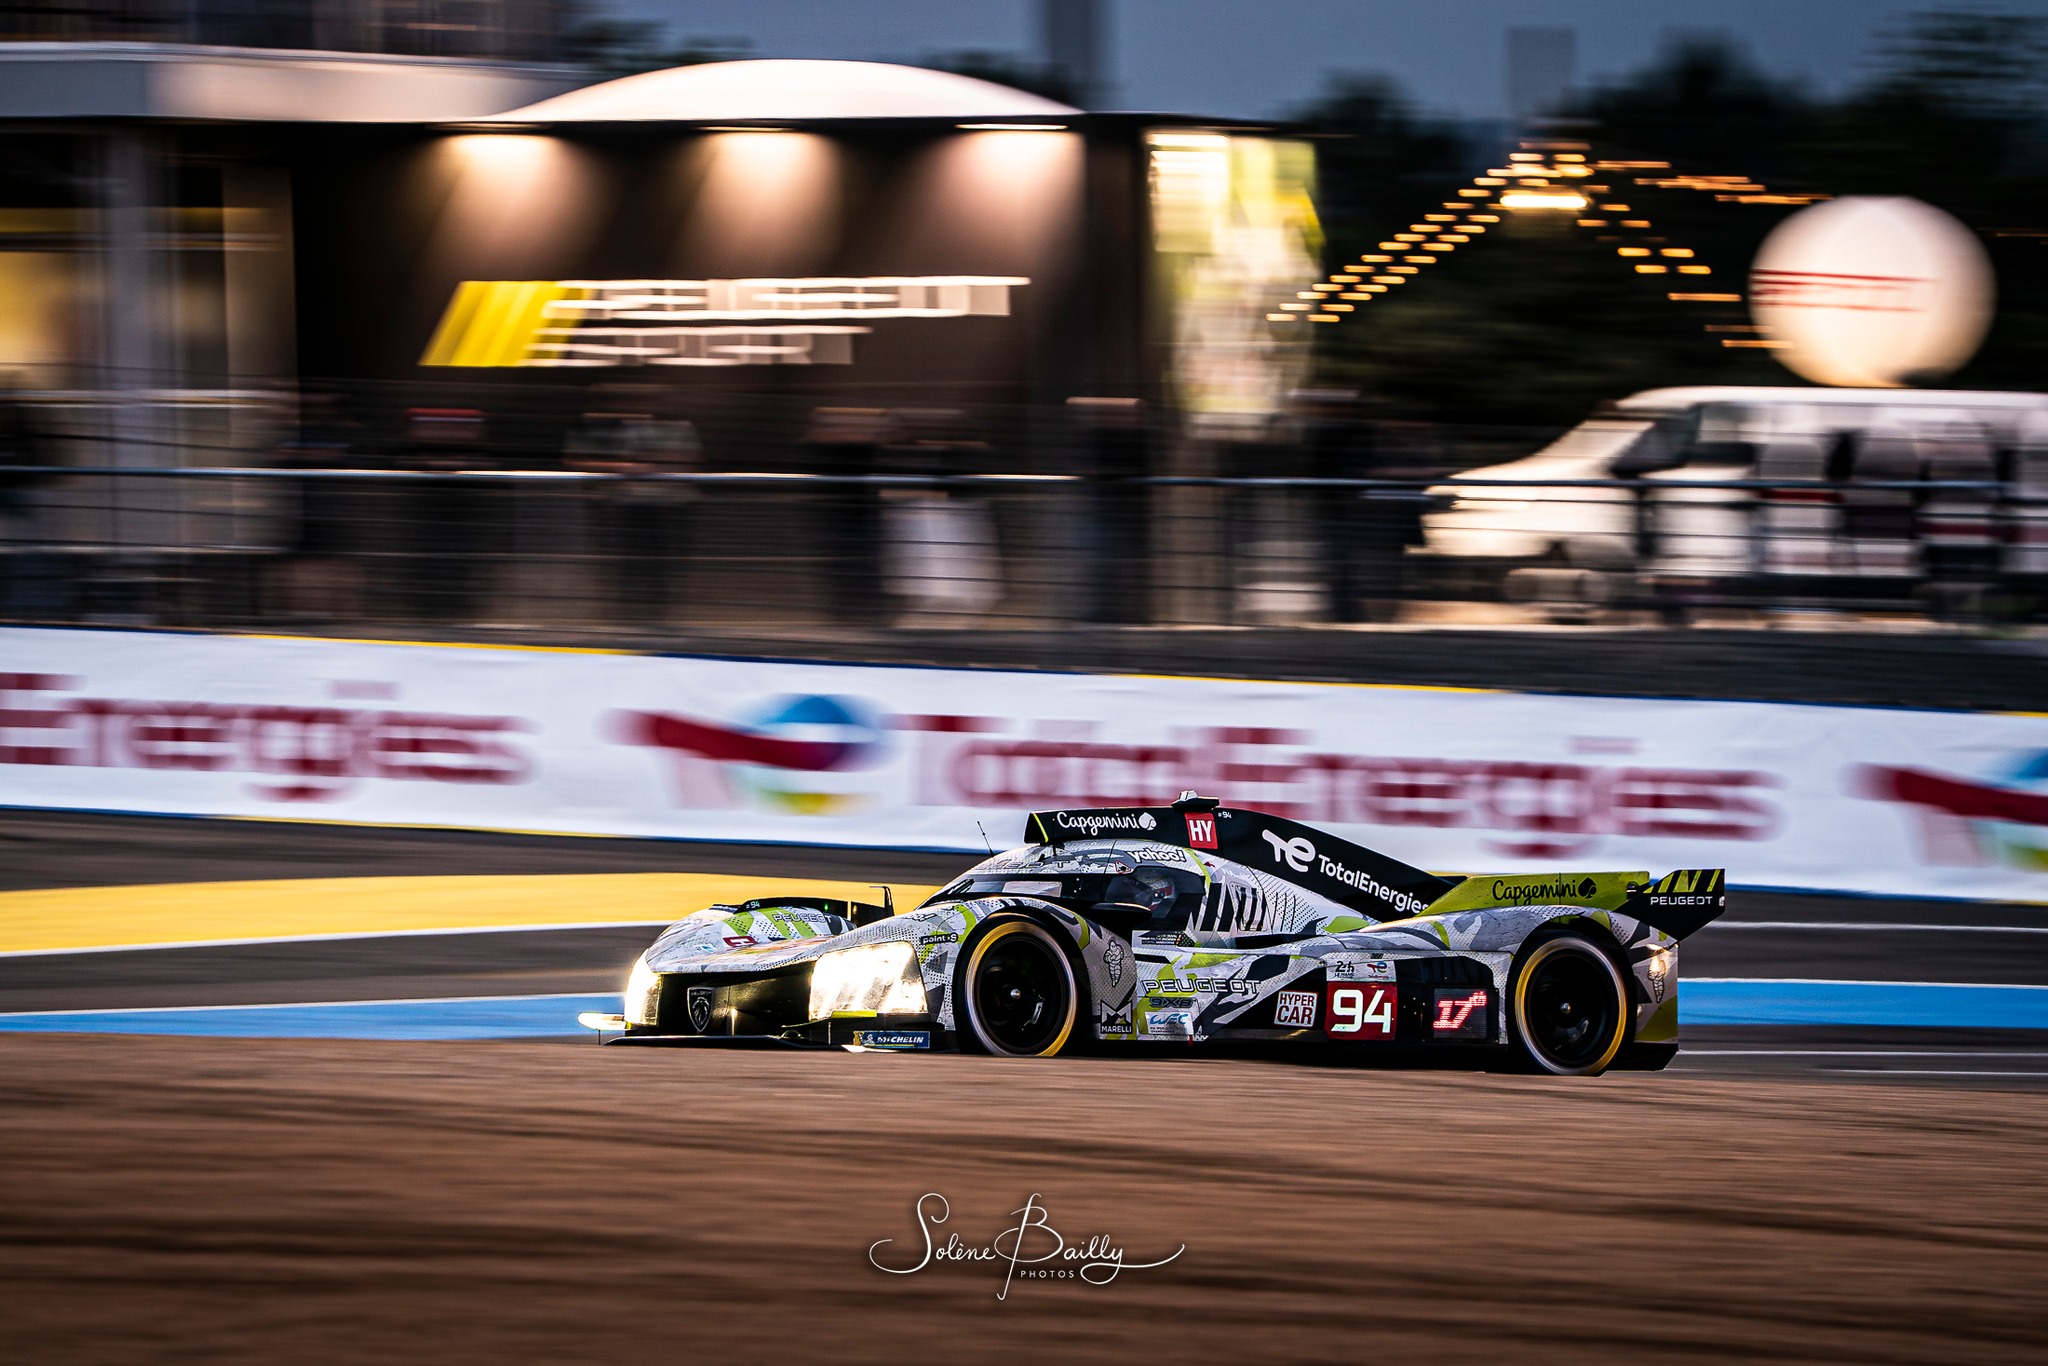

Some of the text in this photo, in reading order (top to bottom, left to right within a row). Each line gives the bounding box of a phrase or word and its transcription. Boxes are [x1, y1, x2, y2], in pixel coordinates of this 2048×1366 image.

[1056, 811, 1140, 836] Capgemini
[1189, 819, 1212, 842] HY
[1127, 848, 1186, 863] yahoo!
[1492, 879, 1578, 906] Capgemini
[1650, 896, 1713, 905] PEUGEOT
[772, 913, 832, 923] PEUGEOT
[922, 935, 946, 944] point
[1142, 978, 1262, 994] PEUGEOT
[1279, 993, 1314, 1007] HYPER
[1150, 1013, 1189, 1024] WEC
[1277, 1005, 1313, 1025] CAR
[1331, 989, 1392, 1034] 94
[1101, 1025, 1131, 1033] MARELLI
